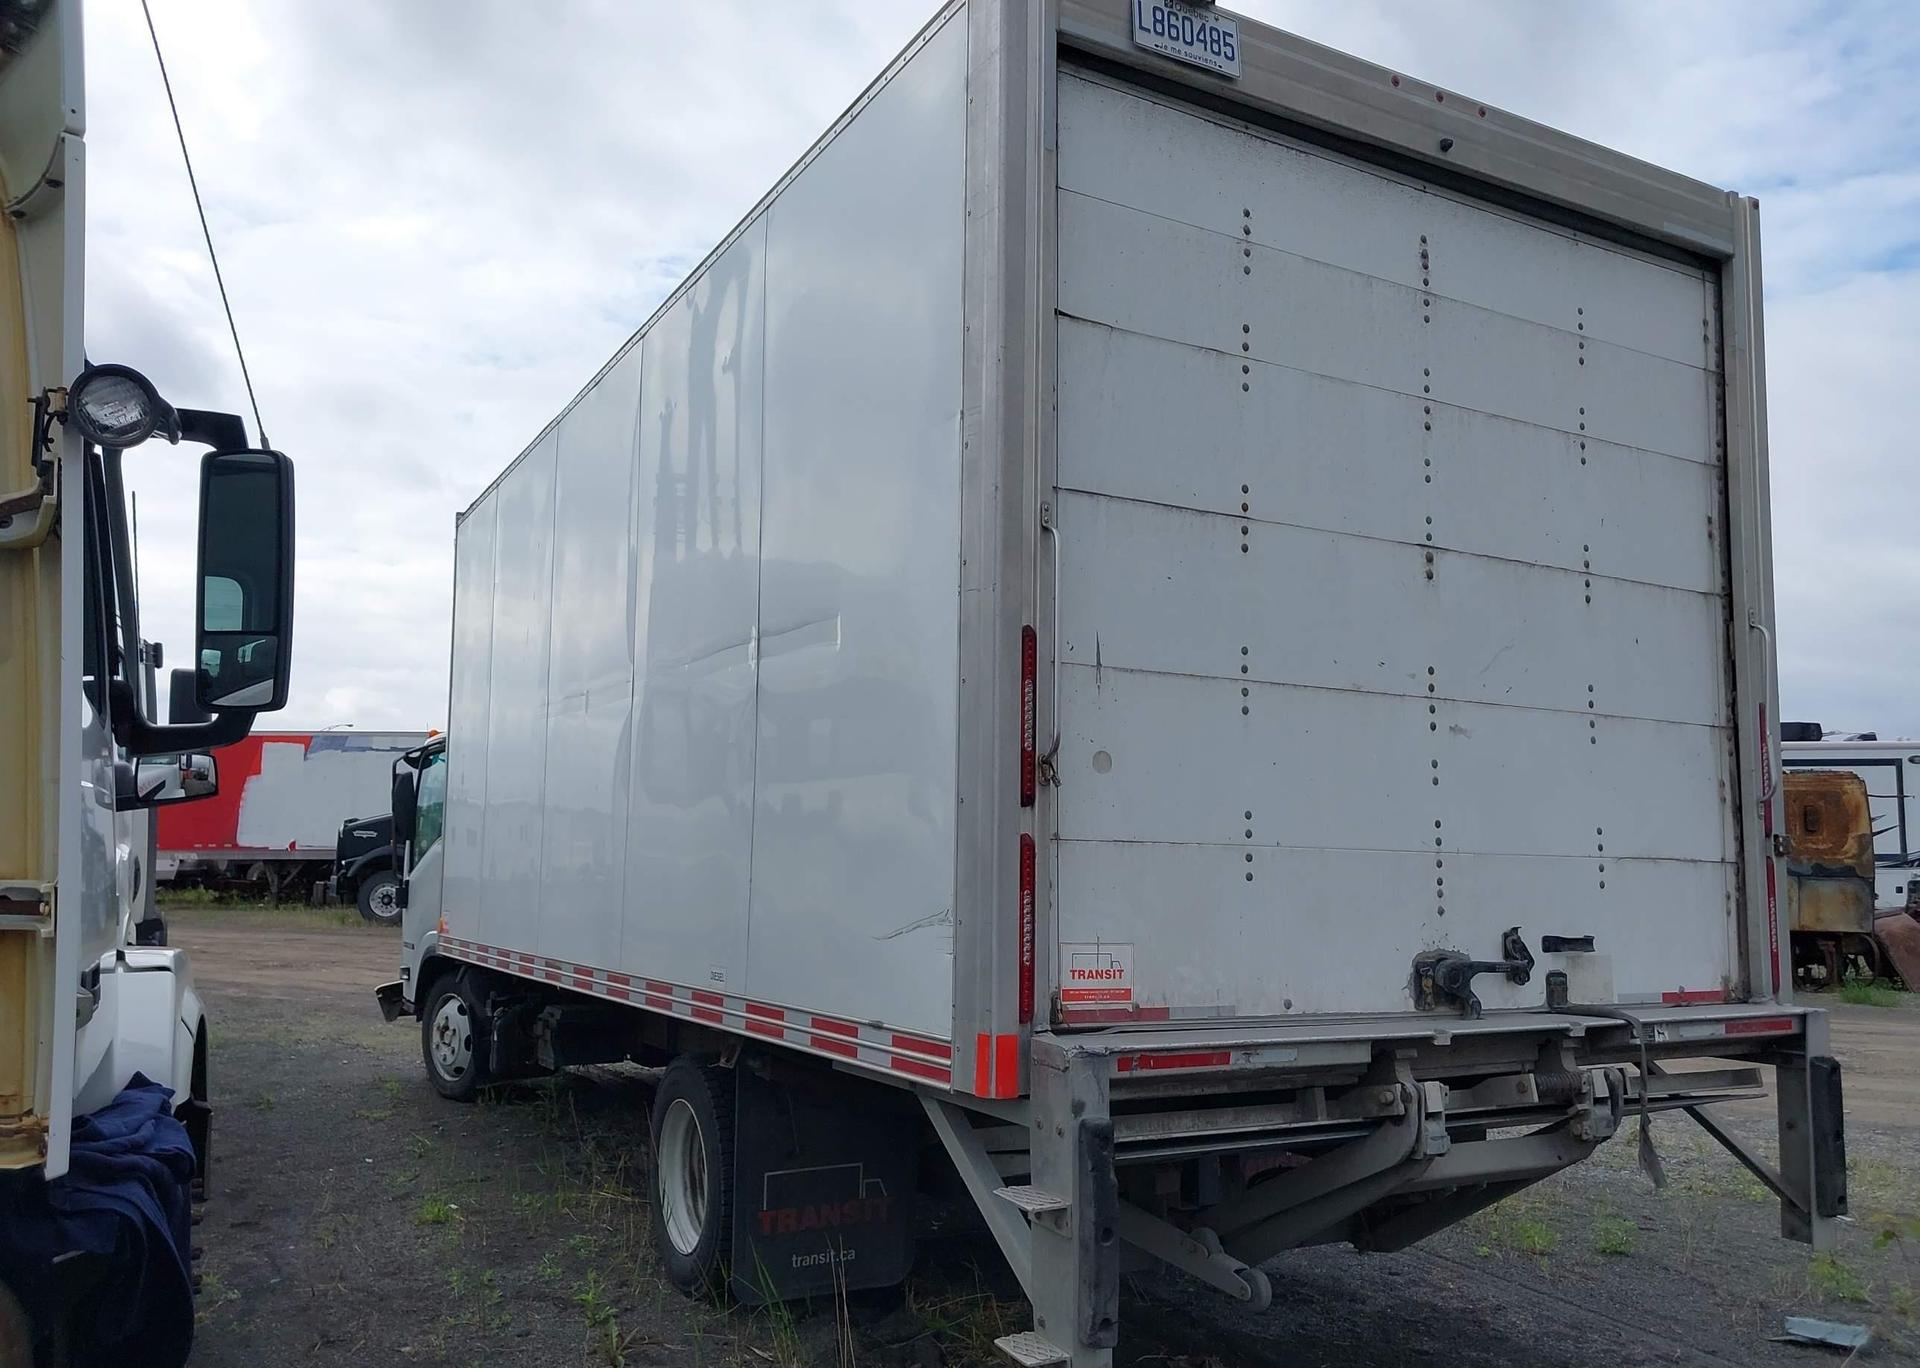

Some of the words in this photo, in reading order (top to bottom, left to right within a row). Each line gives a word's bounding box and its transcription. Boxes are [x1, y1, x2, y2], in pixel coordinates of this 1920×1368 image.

[1137, 0, 1236, 62] L860485
[1170, 46, 1182, 54] me
[1184, 51, 1218, 67] souviens
[1070, 969, 1125, 980] TRANSIT
[758, 1197, 894, 1233] TRANSIT
[791, 1249, 856, 1269] transit.ca
